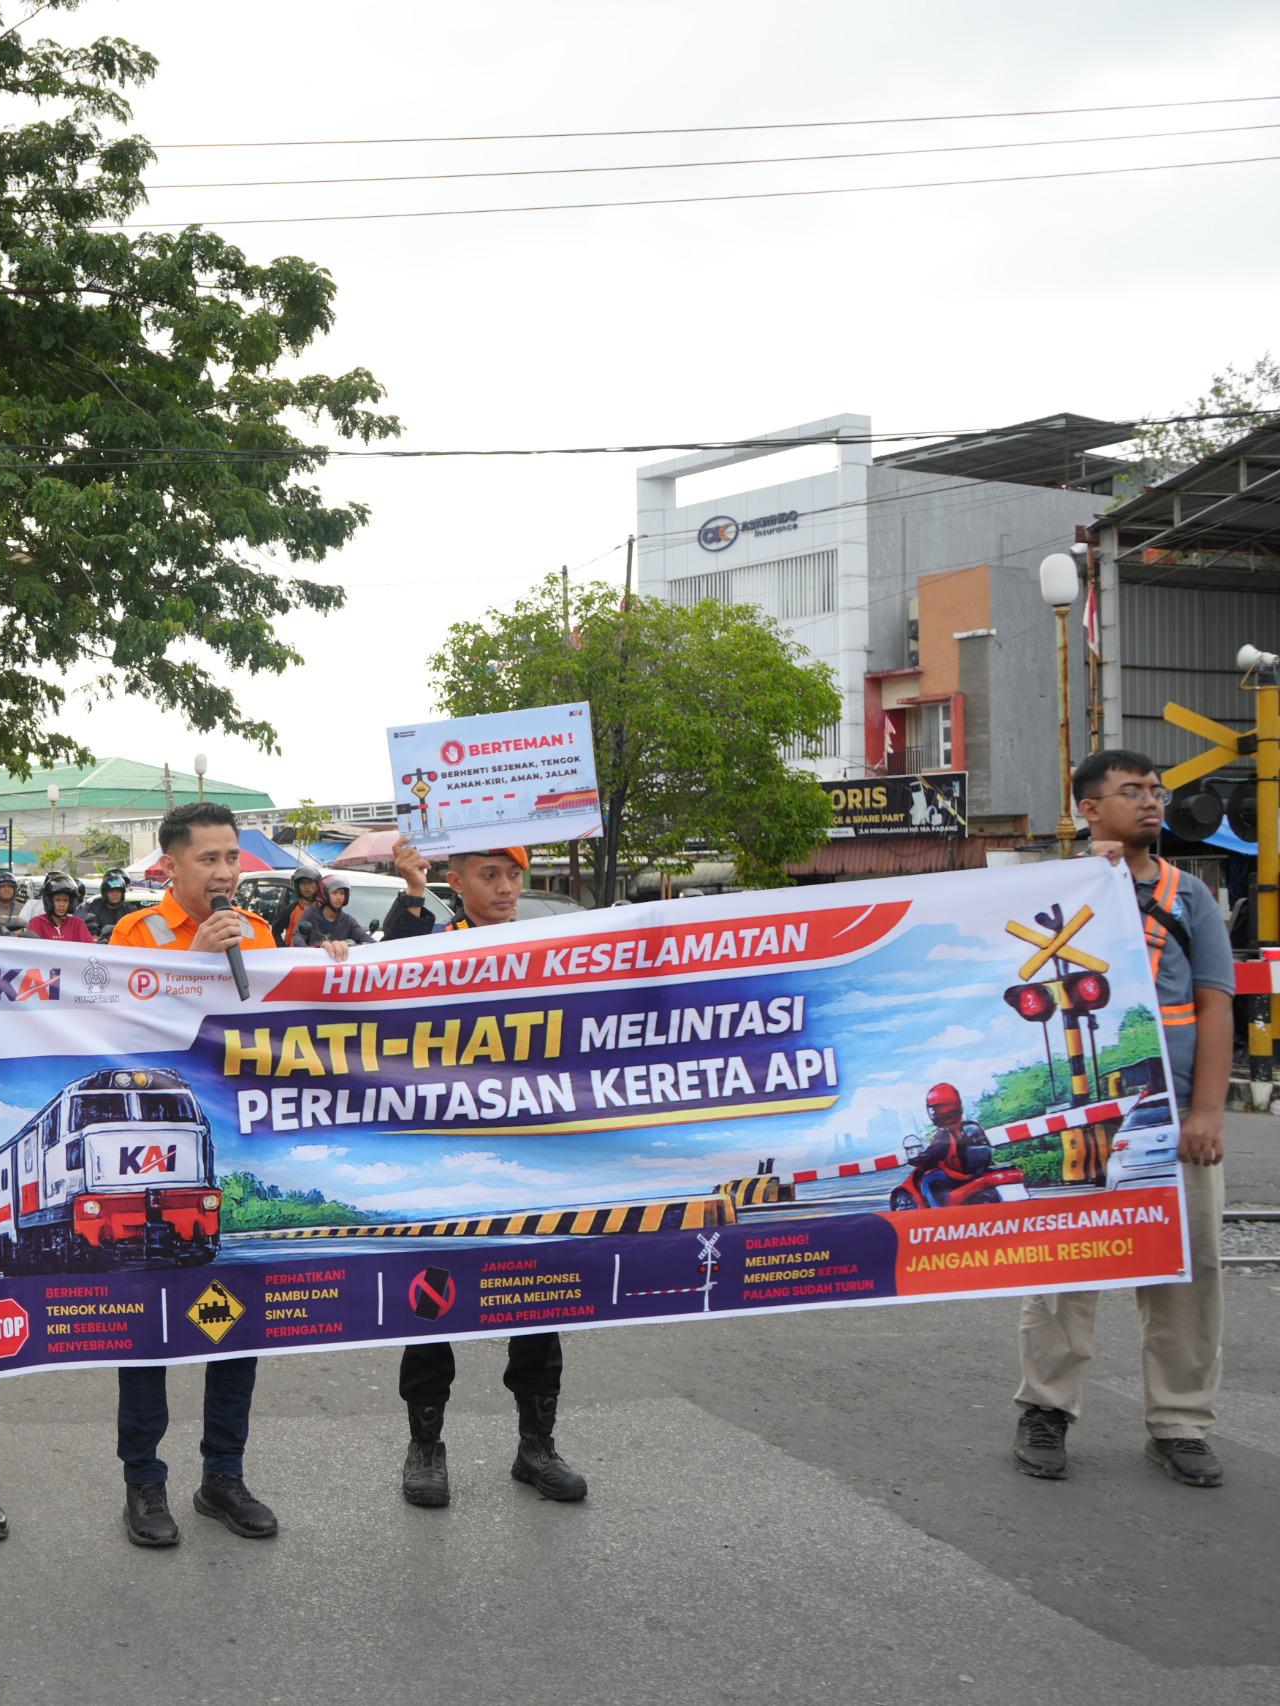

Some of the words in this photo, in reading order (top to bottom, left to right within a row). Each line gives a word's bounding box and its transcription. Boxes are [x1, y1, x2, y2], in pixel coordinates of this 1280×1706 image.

[468, 733, 563, 757] BERTEMAN
[568, 732, 574, 744] !
[441, 767, 489, 779] BERHENTI
[491, 761, 538, 773] SEJENAK,
[541, 756, 581, 766] TENGOK
[447, 776, 508, 790] KANAN-KIRI,
[510, 772, 543, 784] AMAN,
[546, 768, 578, 779] JALAN
[824, 787, 887, 810] ORIS
[852, 814, 880, 824] SPARE
[881, 813, 905, 823] PART
[322, 951, 531, 995] HIMBAUAN
[542, 922, 809, 978] KESELAMATAN
[165, 973, 214, 982] Transport
[166, 985, 203, 996] Padang
[223, 1009, 563, 1077] HATI-HATI
[579, 995, 805, 1053] MELINTASI
[237, 1072, 577, 1135] PERLINTASAN
[590, 1056, 755, 1109] KERETA
[764, 1048, 838, 1093] API
[119, 1145, 176, 1175] KAI
[909, 1218, 1020, 1245] UTAMAKAN
[1022, 1205, 1170, 1233] KESELAMATAN,
[745, 1234, 809, 1250] DILARANG!
[745, 1253, 802, 1268] MELINTAS
[804, 1250, 830, 1263] DAN
[906, 1248, 990, 1273] JANGAN
[993, 1244, 1054, 1267] AMBIL
[1057, 1238, 1134, 1262] RESIKO!
[481, 1260, 537, 1273] JANGAN!
[743, 1268, 816, 1284] MENEROBOS
[817, 1264, 858, 1277] KETIKA
[265, 1268, 346, 1286] PERHATIKAN!
[480, 1276, 534, 1289] BERMAIN
[537, 1272, 581, 1286] PONSEL
[45, 1286, 109, 1300] BERHENTI!
[265, 1290, 309, 1303] RAMBU
[312, 1288, 338, 1300] DAN
[480, 1294, 522, 1308] KETIKA
[524, 1288, 582, 1303] MELINTAS
[743, 1286, 790, 1300] PALANG
[792, 1283, 832, 1297] SUDAH
[834, 1280, 874, 1293] TURUN
[46, 1304, 97, 1318] TENGOK
[99, 1302, 144, 1316] KANAN
[265, 1308, 308, 1321] SINYAL
[480, 1312, 513, 1325] PADA
[516, 1304, 594, 1322] PERLINTASAN
[47, 1322, 70, 1335] KIRI
[73, 1321, 128, 1334] SEBELUM
[265, 1322, 342, 1338] PERINGATAN
[48, 1339, 134, 1353] MENYEBRANG
